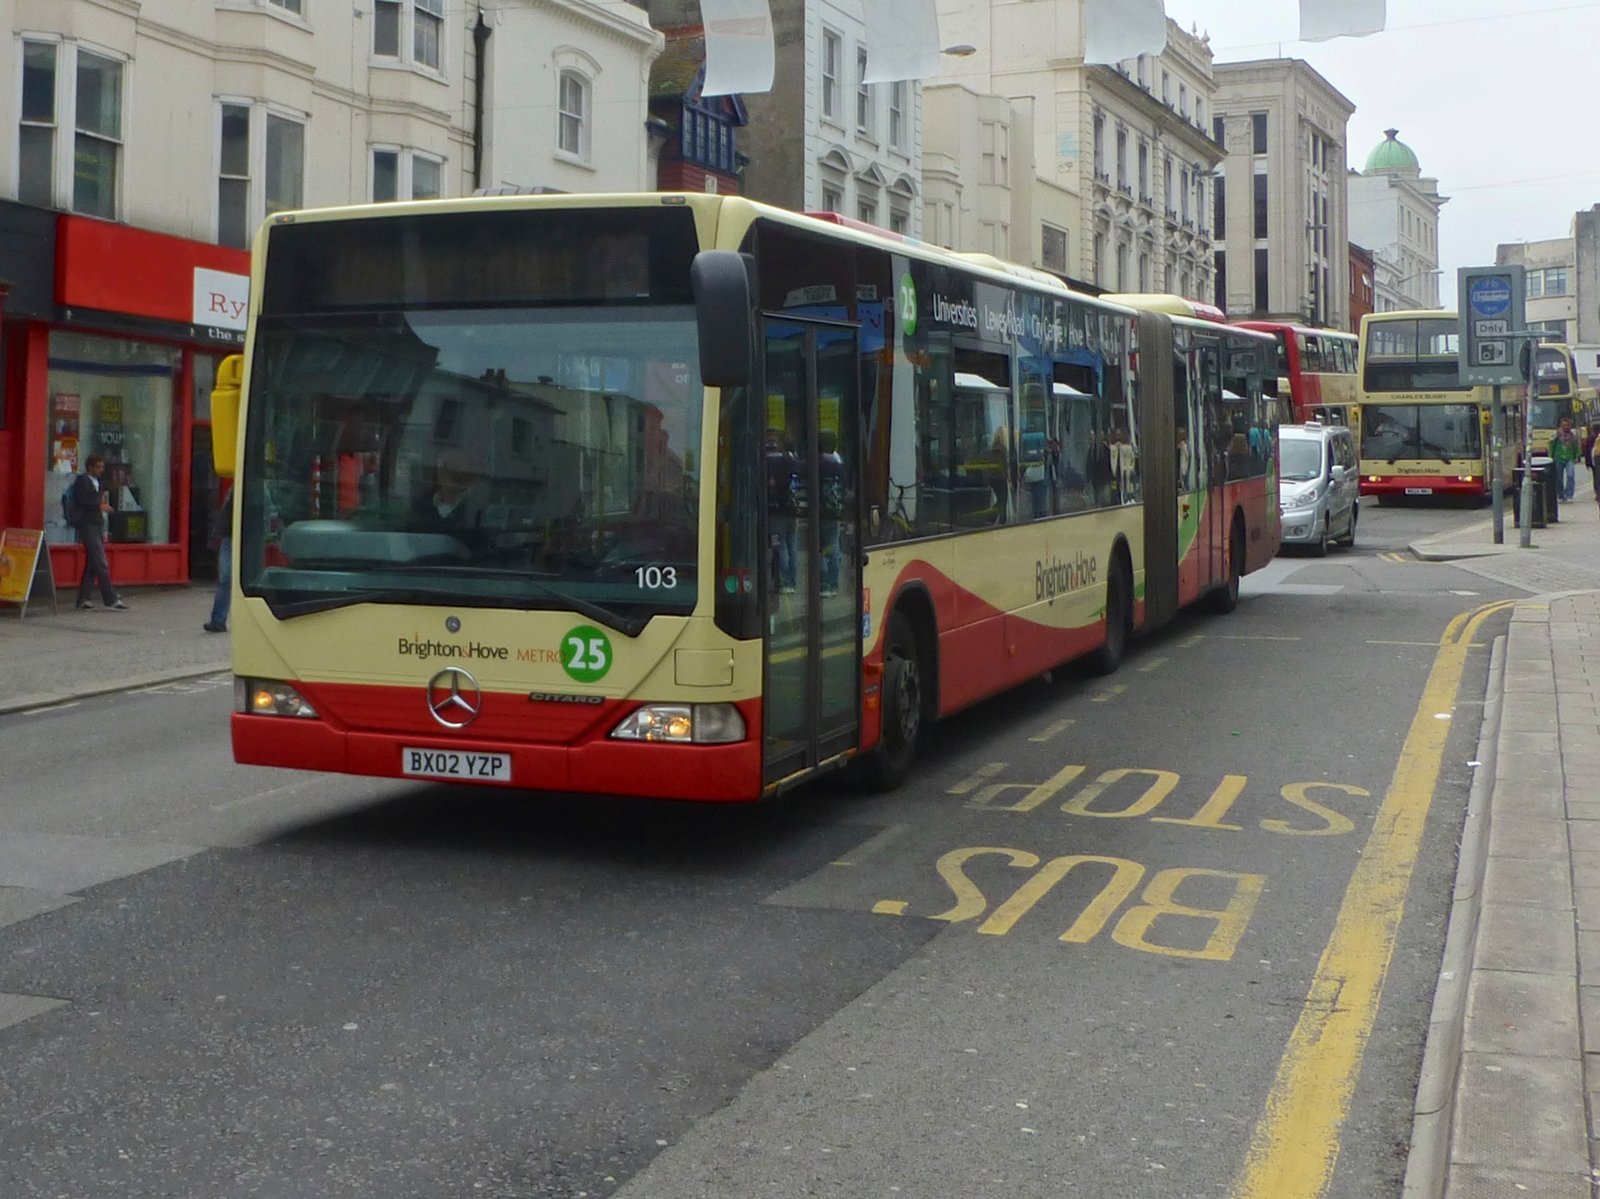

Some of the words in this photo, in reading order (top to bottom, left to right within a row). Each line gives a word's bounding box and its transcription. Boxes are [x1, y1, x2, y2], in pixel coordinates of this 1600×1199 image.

[902, 286, 915, 321] 25
[933, 293, 977, 329] Universities
[985, 304, 1007, 333] Lewes
[1008, 308, 1025, 340] Road
[208, 328, 232, 342] the
[635, 566, 677, 589] 103
[517, 648, 565, 664] METRO
[568, 637, 606, 670] 25
[531, 692, 602, 704] CITARO
[411, 750, 460, 775] BX02
[466, 755, 503, 777] YZP
[963, 764, 1371, 836] STOP
[873, 846, 1268, 961] BUS
